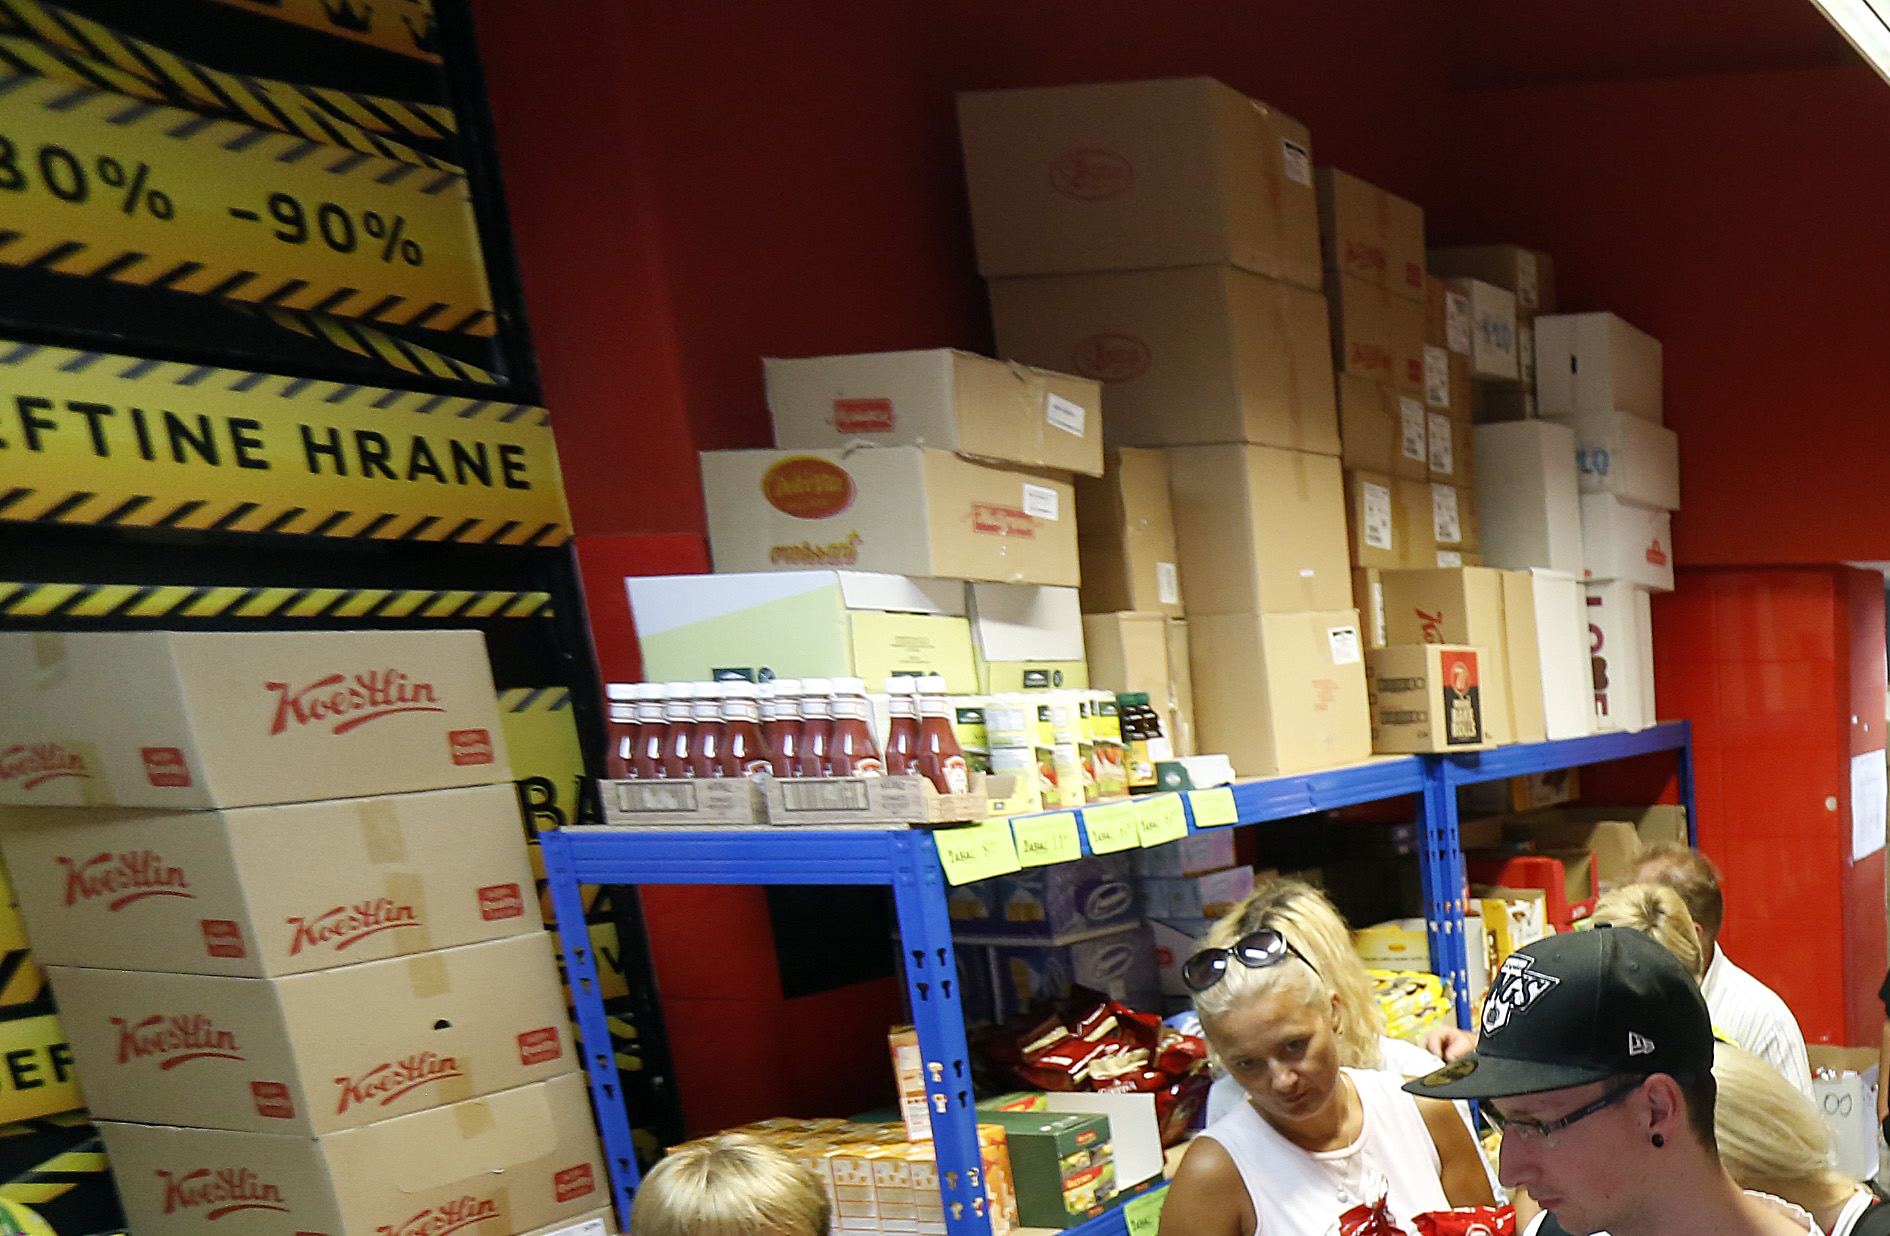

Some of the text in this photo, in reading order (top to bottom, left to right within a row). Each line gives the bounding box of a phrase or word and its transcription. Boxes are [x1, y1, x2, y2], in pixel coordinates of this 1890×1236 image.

[230, 194, 424, 267] -90%
[0, 397, 532, 491] FTINE HRANE
[265, 669, 445, 736] Koestlin
[57, 850, 197, 912] Koestlin
[287, 897, 422, 956] Koestlin
[0, 1042, 76, 1091] EF
[110, 1014, 246, 1070] Koestlin
[336, 1051, 463, 1115] Koestlin
